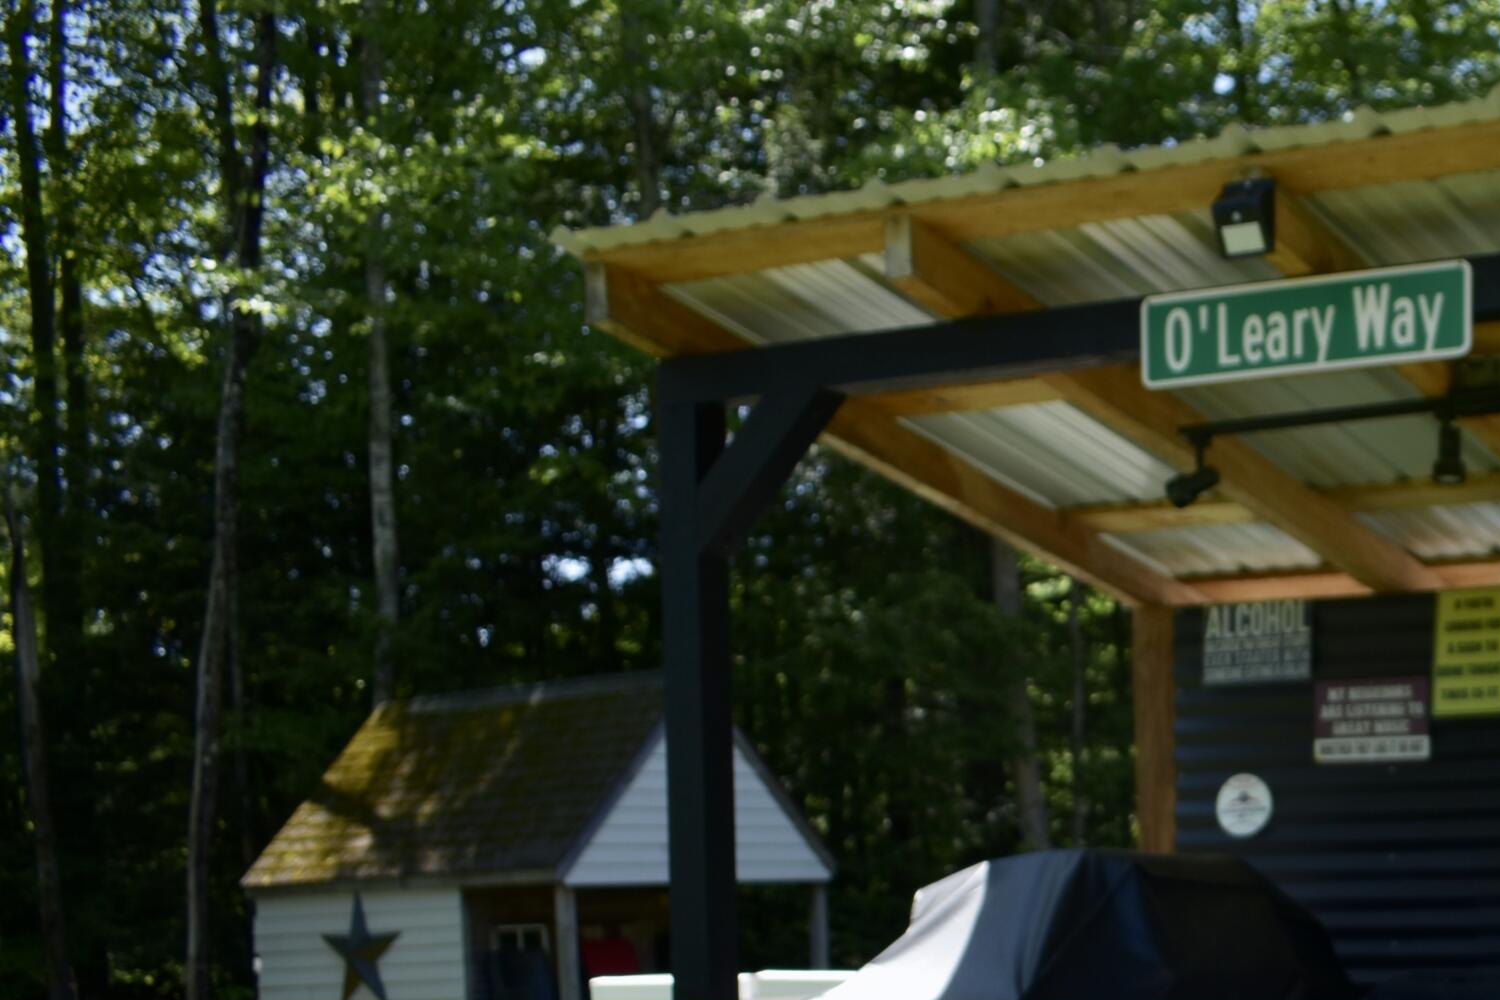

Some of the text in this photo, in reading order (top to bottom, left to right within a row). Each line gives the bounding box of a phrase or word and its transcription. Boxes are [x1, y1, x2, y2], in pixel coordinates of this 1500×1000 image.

[1163, 282, 1445, 374] O'Leary Way
[1205, 599, 1311, 638] ALCOHOL
